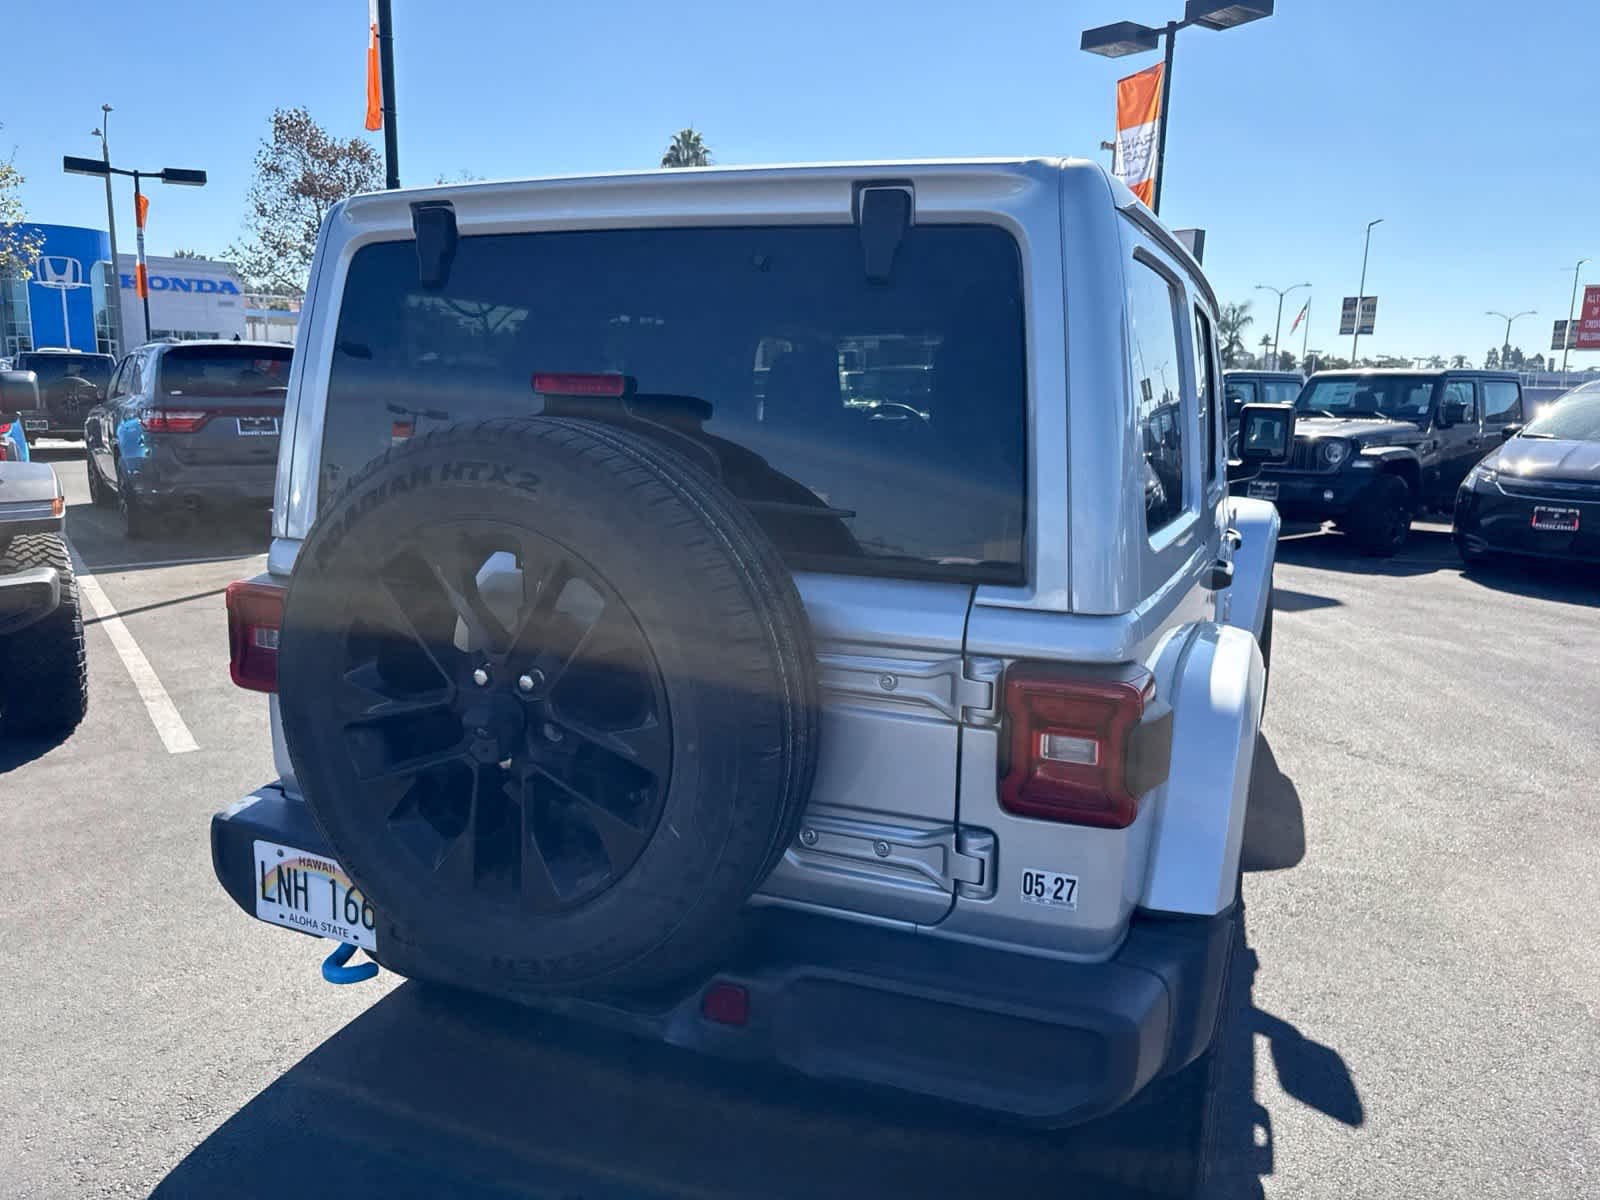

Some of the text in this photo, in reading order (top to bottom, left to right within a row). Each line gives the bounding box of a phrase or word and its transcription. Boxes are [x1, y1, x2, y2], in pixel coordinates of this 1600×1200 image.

[119, 273, 240, 295] HONDA
[298, 856, 336, 875] HAWAII
[260, 860, 375, 931] LNH 166
[1022, 871, 1077, 902] 05 27
[288, 913, 349, 938] ALOHA STATE
